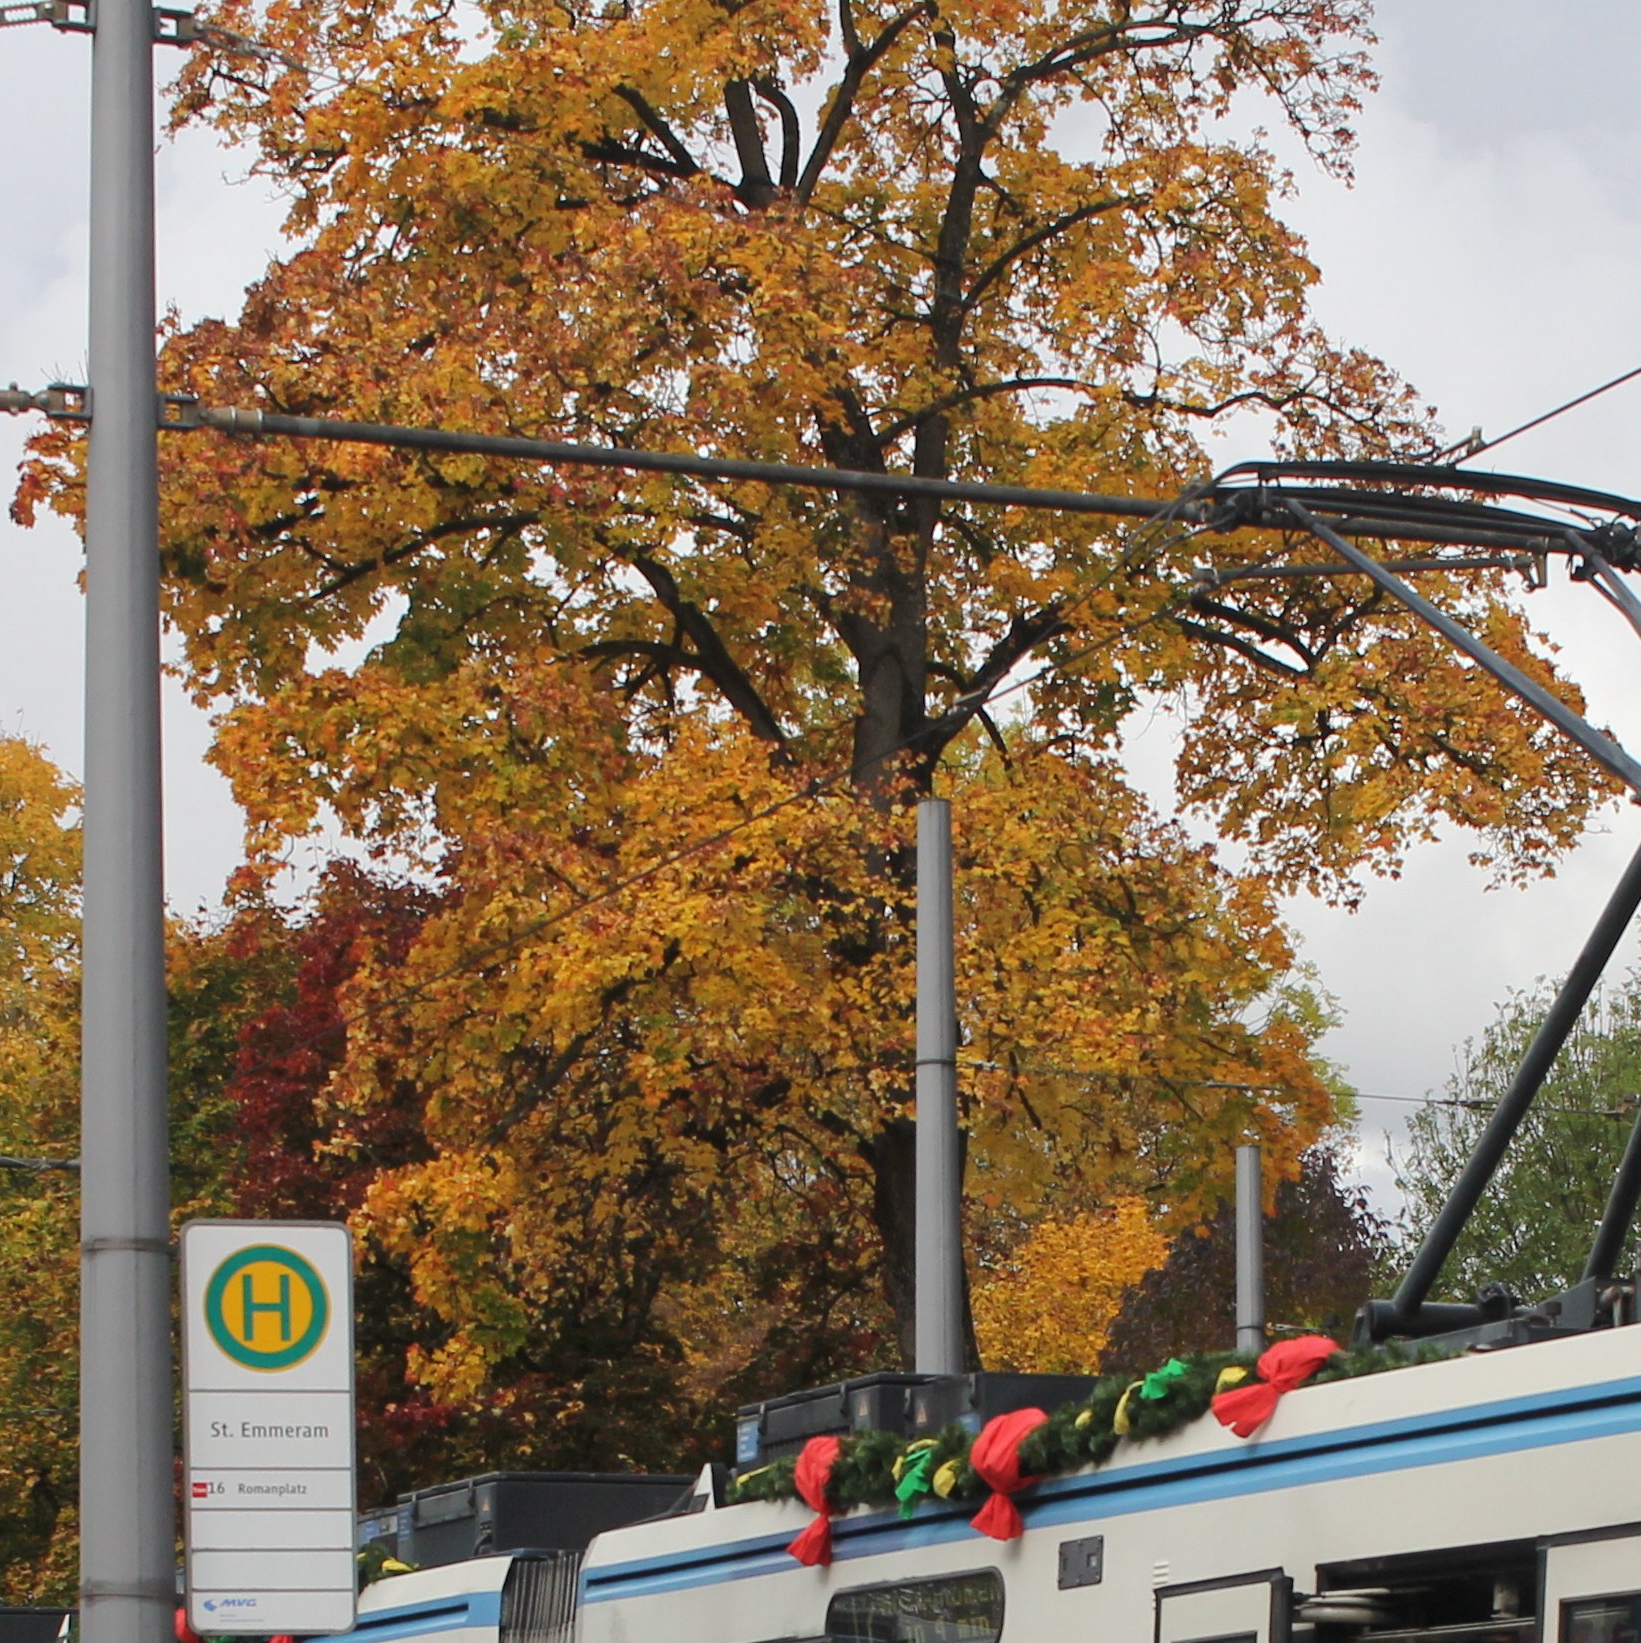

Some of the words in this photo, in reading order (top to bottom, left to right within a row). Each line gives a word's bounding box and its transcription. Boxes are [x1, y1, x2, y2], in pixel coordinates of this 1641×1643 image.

[242, 1274, 292, 1341] H
[210, 1421, 234, 1438] St.
[241, 1421, 329, 1438] Emmeram
[208, 1482, 225, 1494] 16
[238, 1483, 307, 1496] Romanplatz
[220, 1599, 257, 1607] MVG
